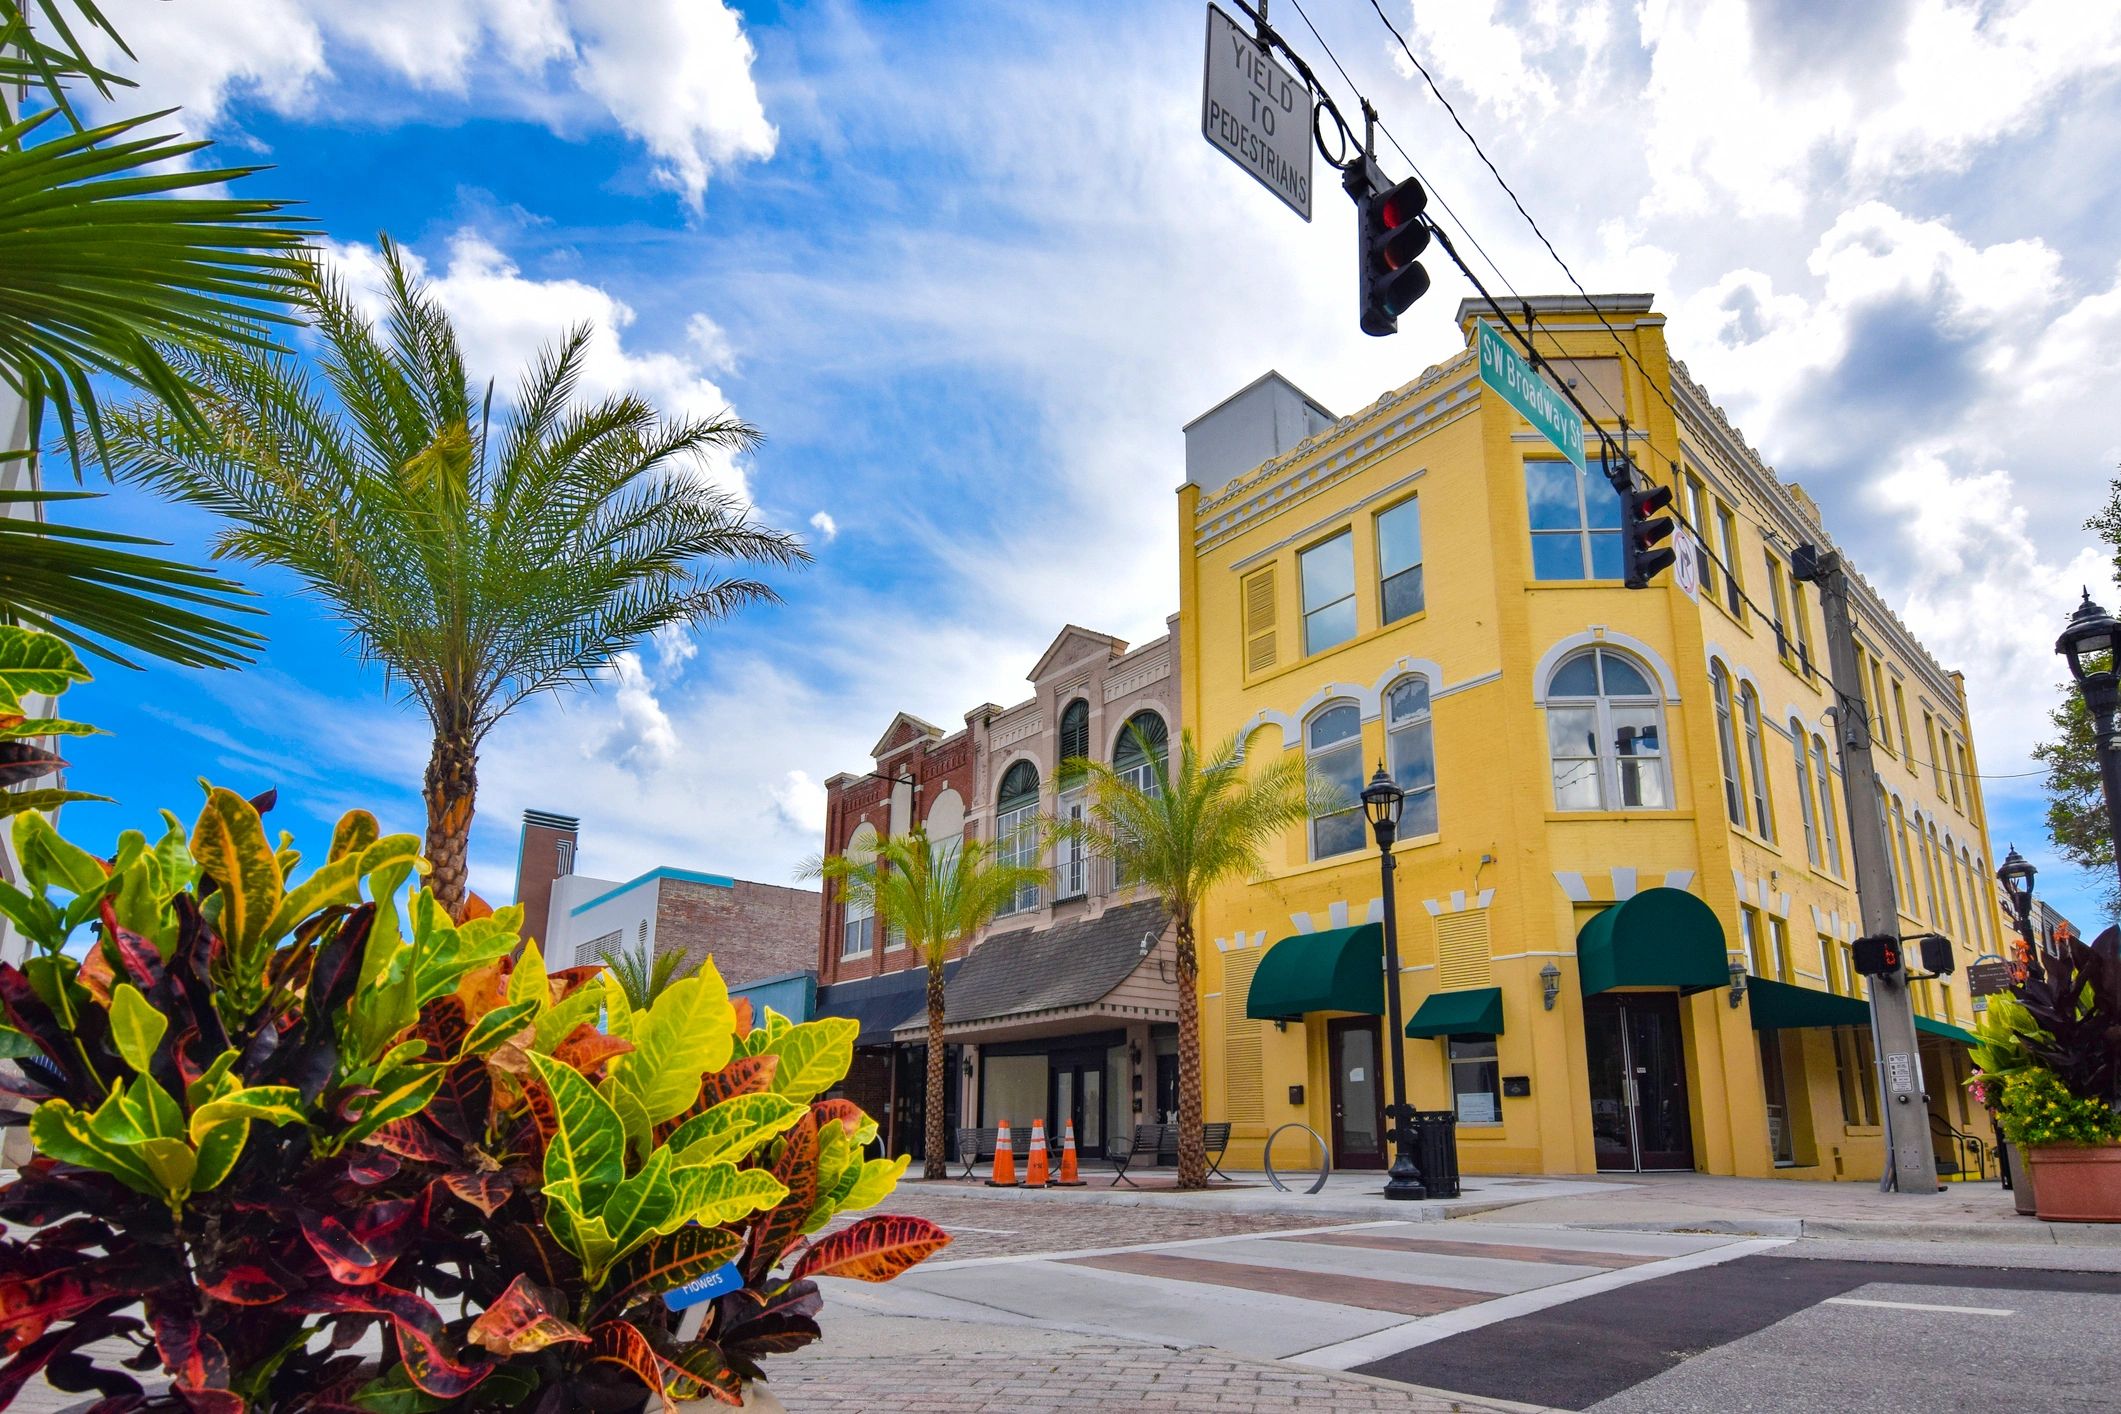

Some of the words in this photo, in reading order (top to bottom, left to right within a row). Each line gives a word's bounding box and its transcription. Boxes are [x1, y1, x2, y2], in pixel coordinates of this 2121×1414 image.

[1232, 35, 1292, 113] YIELD
[1249, 90, 1275, 136] TO
[1210, 99, 1306, 204] PEDESTRIANS
[1483, 333, 1503, 377] SW
[1507, 353, 1567, 446] Broadway
[1570, 419, 1583, 454] St
